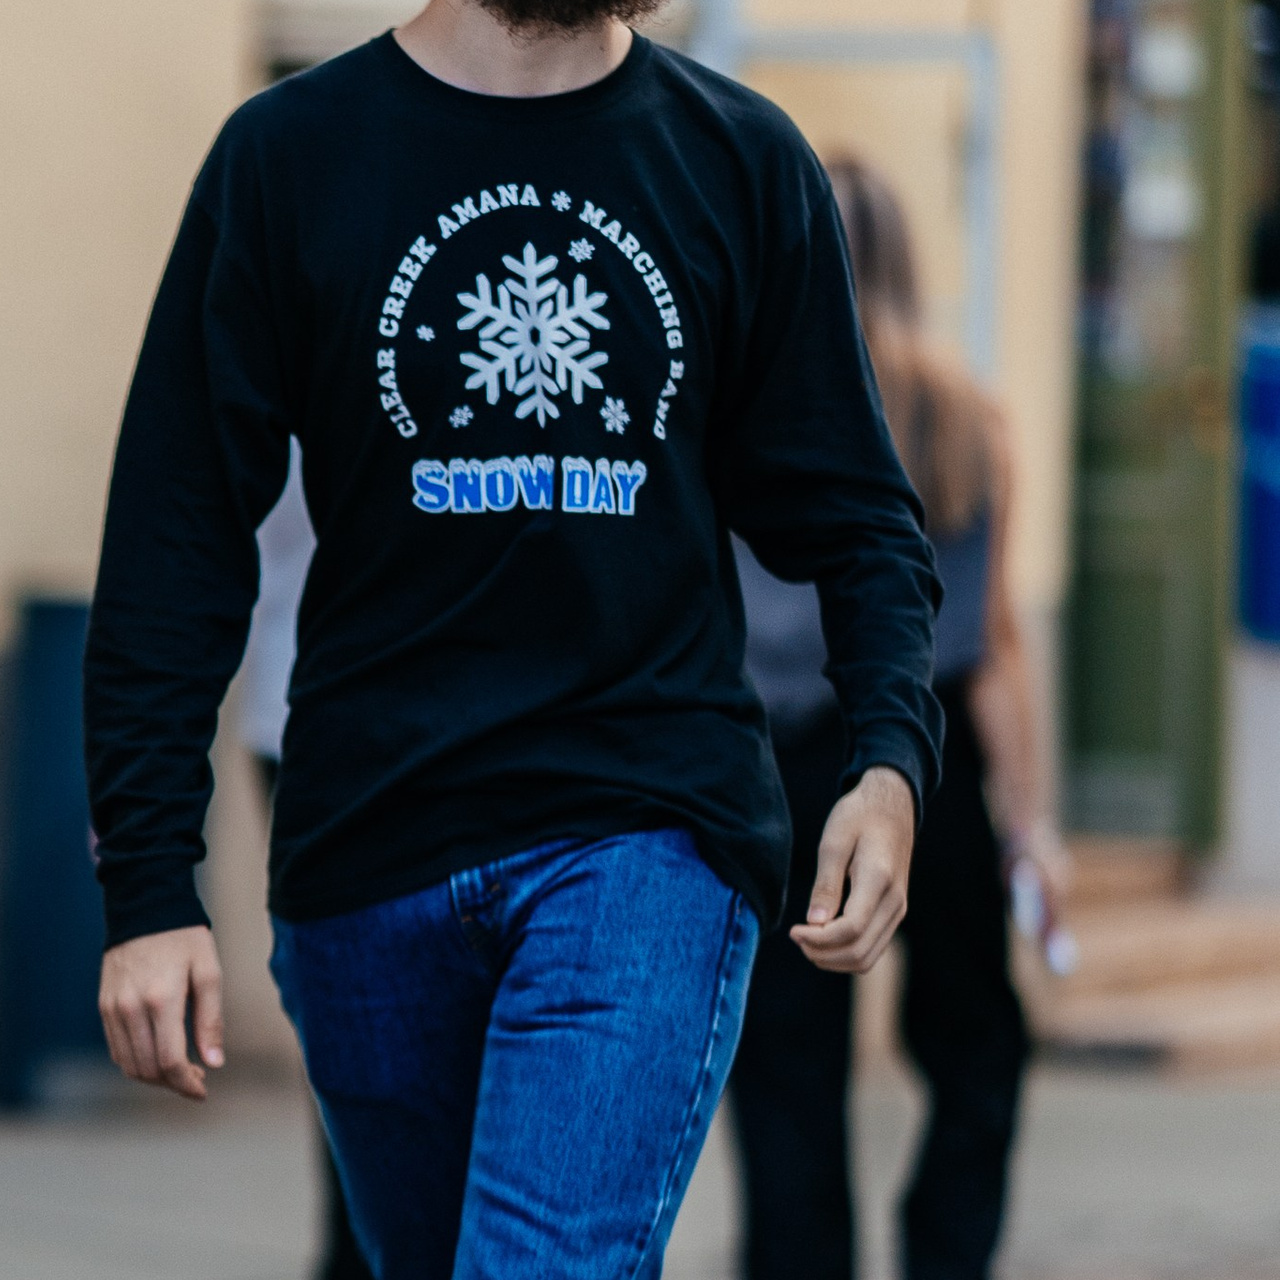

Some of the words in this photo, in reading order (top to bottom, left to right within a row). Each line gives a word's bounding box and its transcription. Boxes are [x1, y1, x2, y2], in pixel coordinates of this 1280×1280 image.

[437, 183, 541, 240] AMANA
[379, 235, 437, 338] CREEK
[579, 200, 683, 349] MARCHING
[376, 348, 418, 438] CLEAR
[654, 359, 685, 440] BAND
[412, 455, 555, 513] SNOW
[561, 457, 647, 516] DAY
